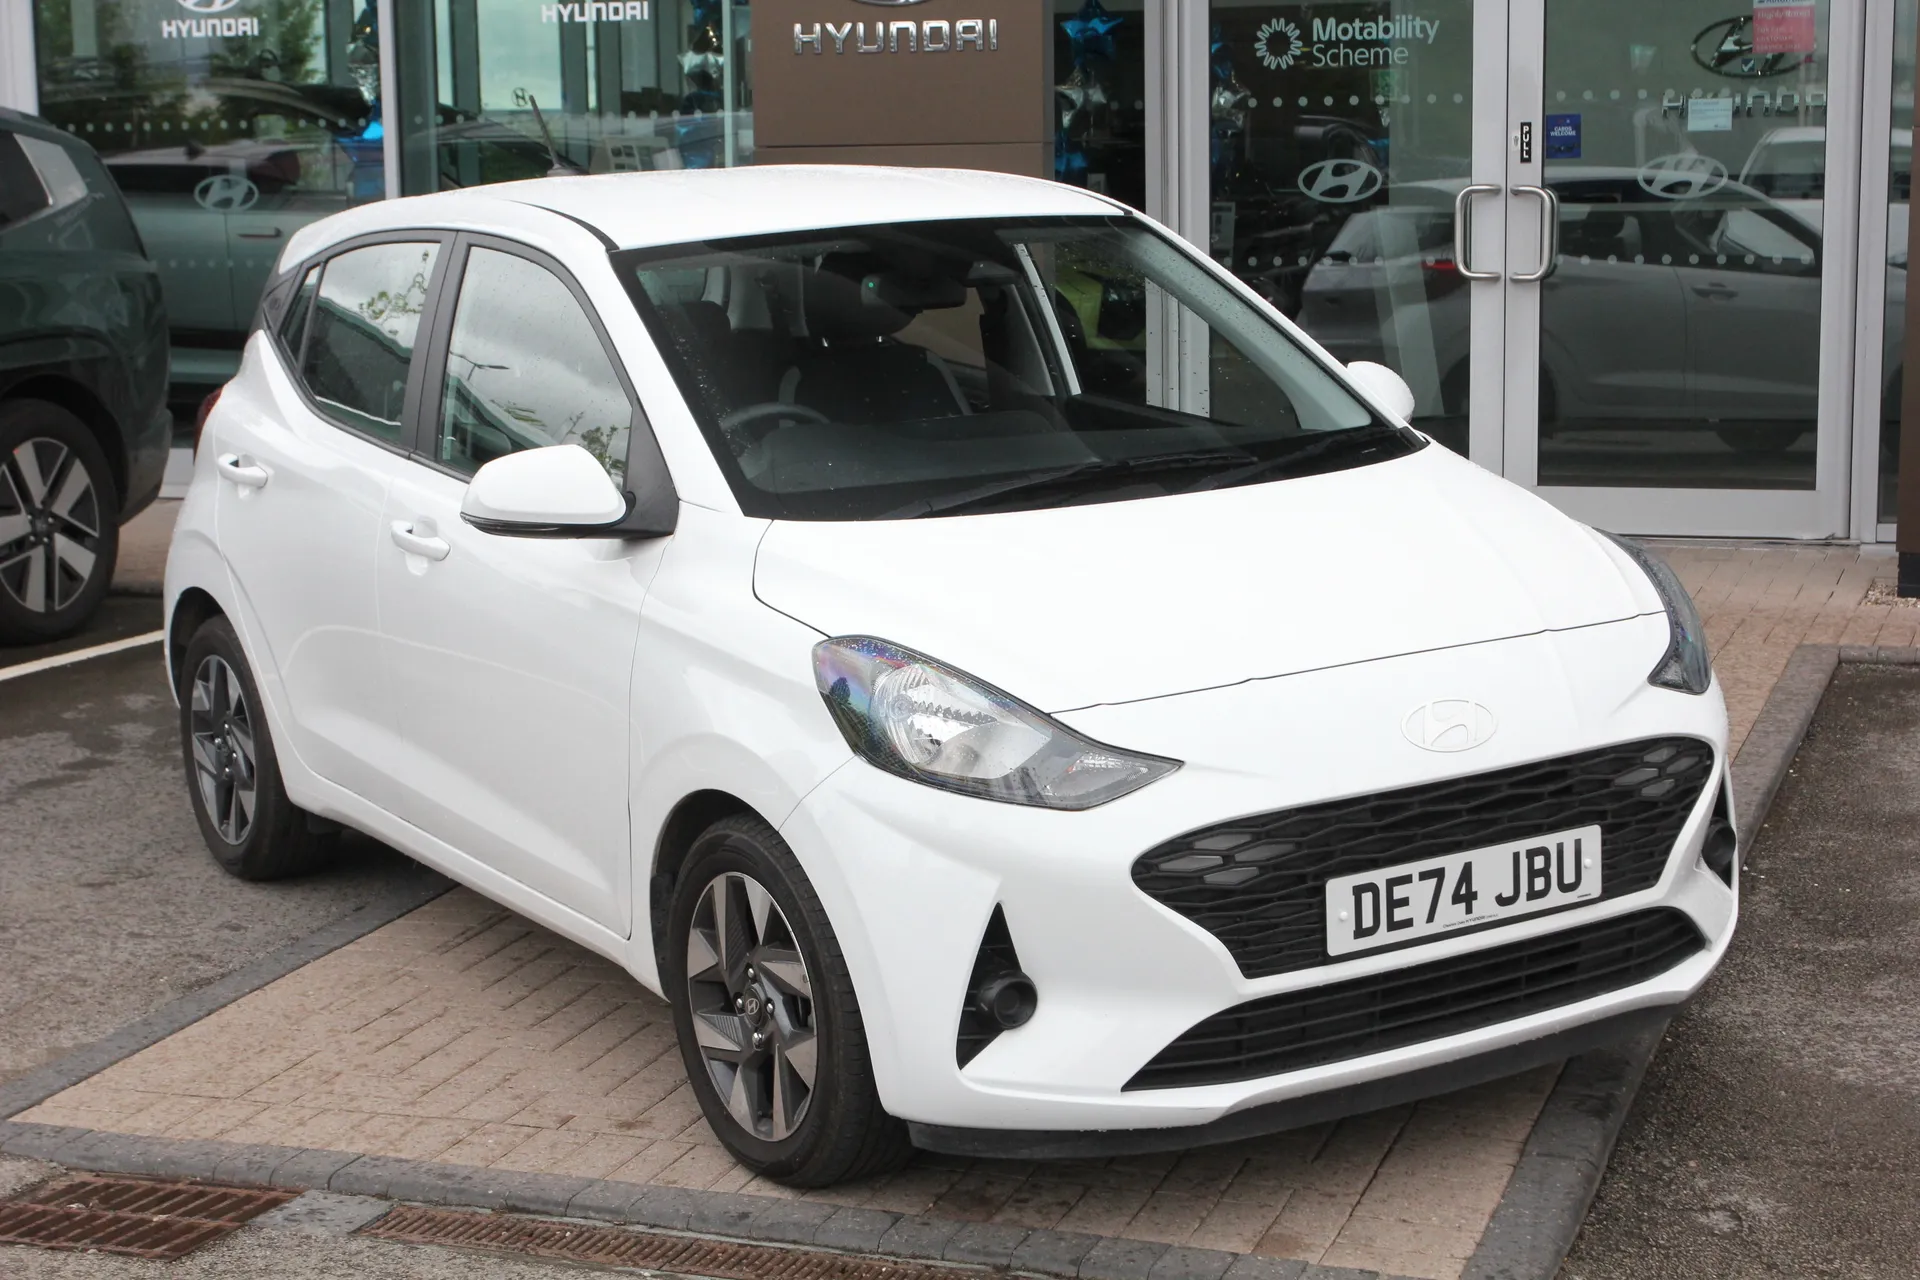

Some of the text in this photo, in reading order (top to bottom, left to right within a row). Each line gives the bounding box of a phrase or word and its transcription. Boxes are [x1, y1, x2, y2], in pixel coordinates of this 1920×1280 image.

[541, 1, 648, 23] HYUNDAI
[162, 17, 259, 38] HYUNDAI
[793, 18, 998, 54] HYUNDAI
[1312, 15, 1440, 44] Motability
[1312, 43, 1409, 67] Scheme
[1522, 125, 1530, 158] PULL
[1352, 838, 1583, 940] DE74 JBU
